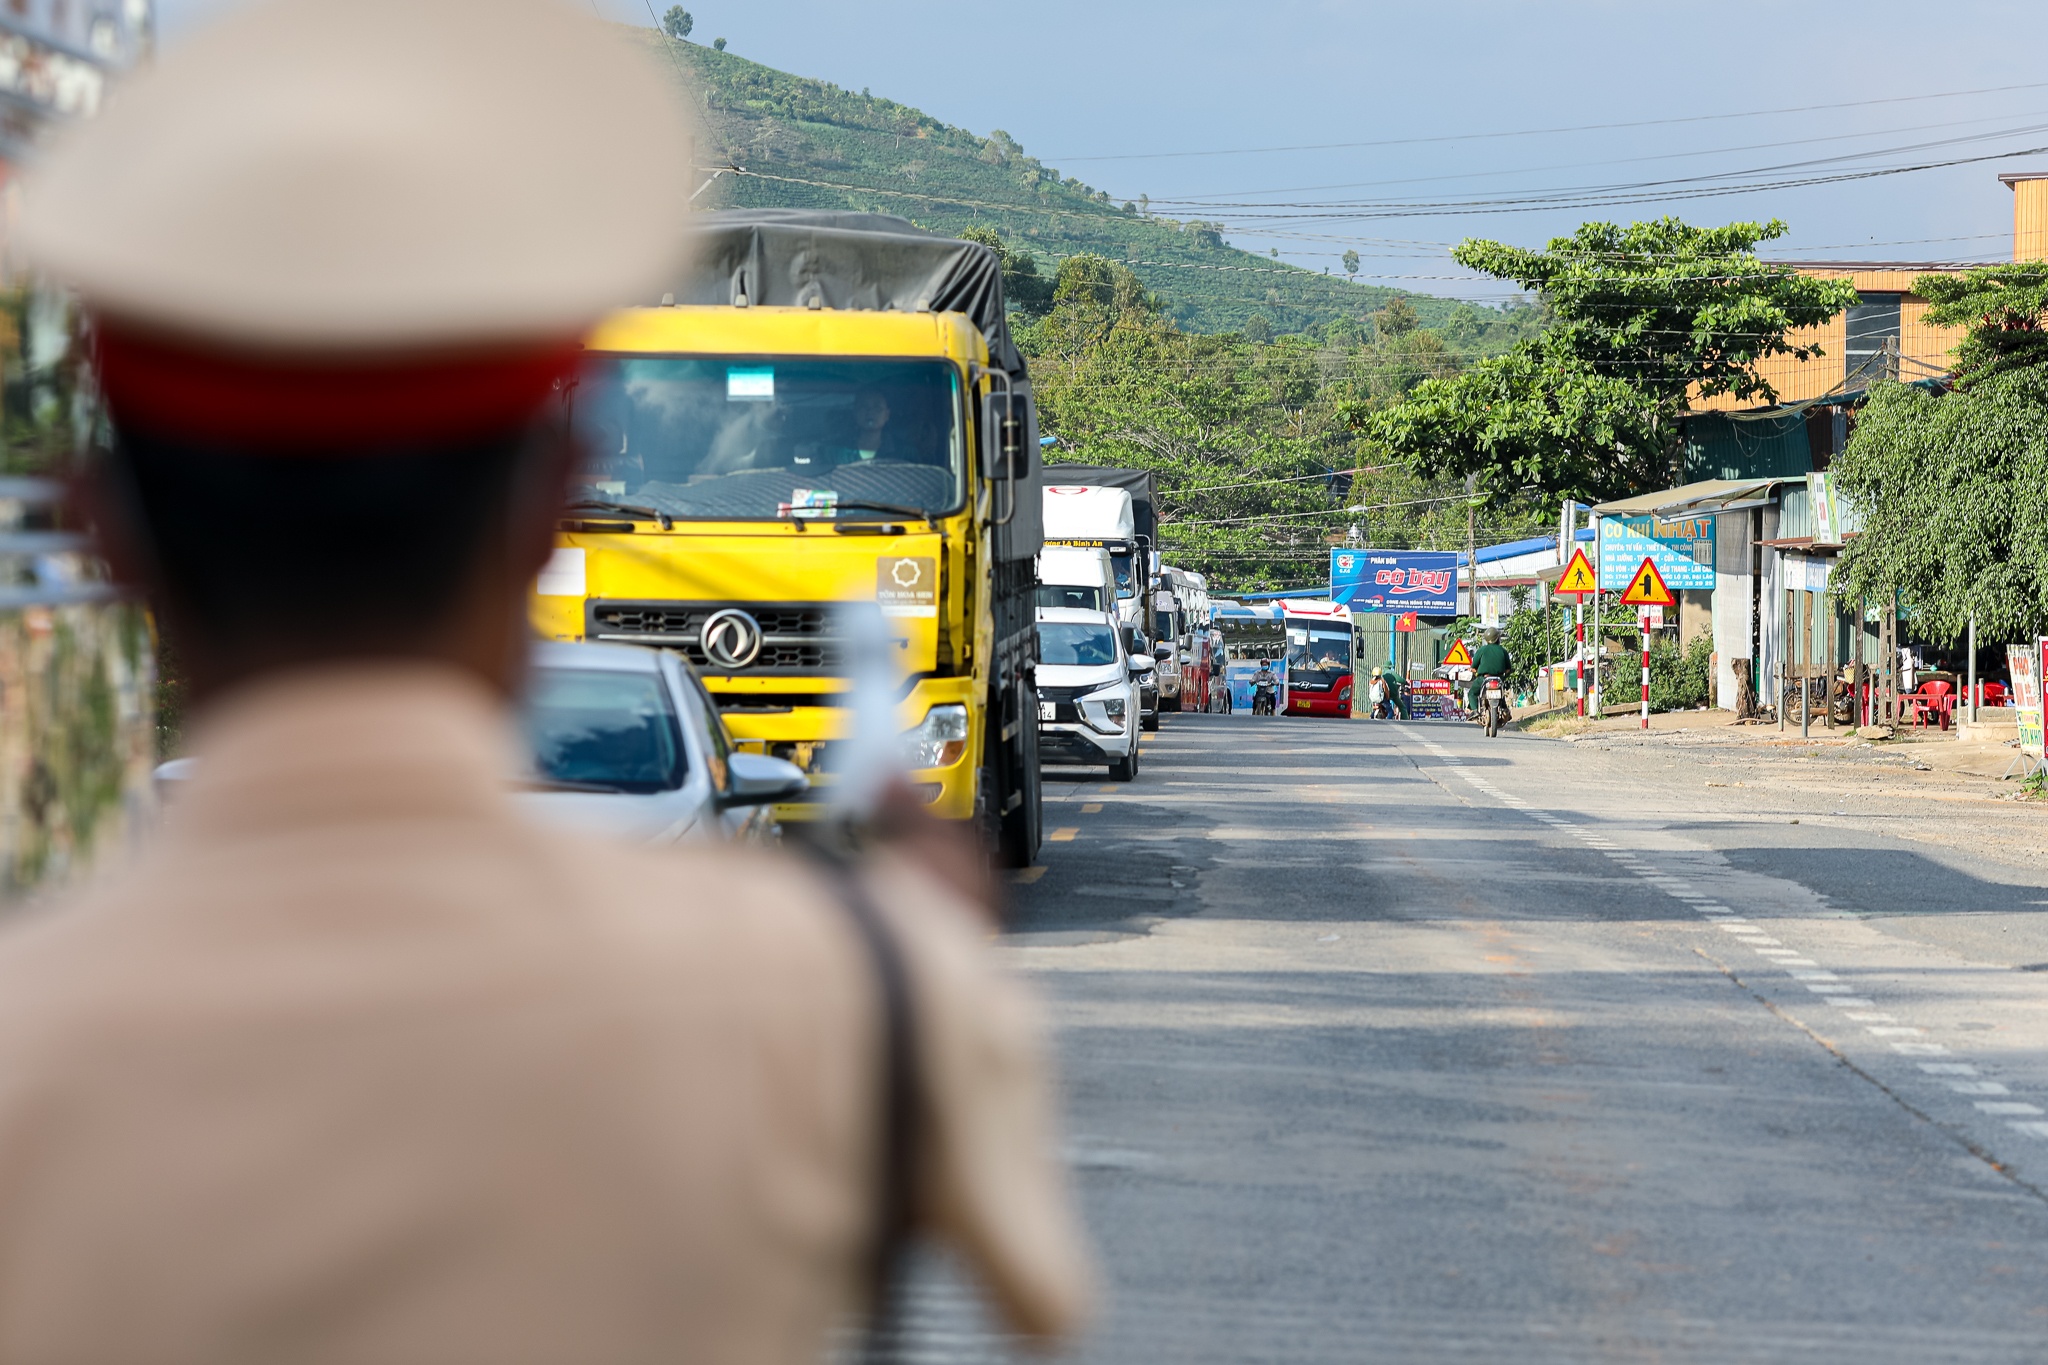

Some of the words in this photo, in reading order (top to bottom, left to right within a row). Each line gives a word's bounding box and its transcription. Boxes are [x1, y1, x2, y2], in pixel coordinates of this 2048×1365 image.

[1605, 521, 1624, 538] CƠ
[1627, 520, 1650, 538] KHÍ
[1408, 568, 1451, 594] bay
